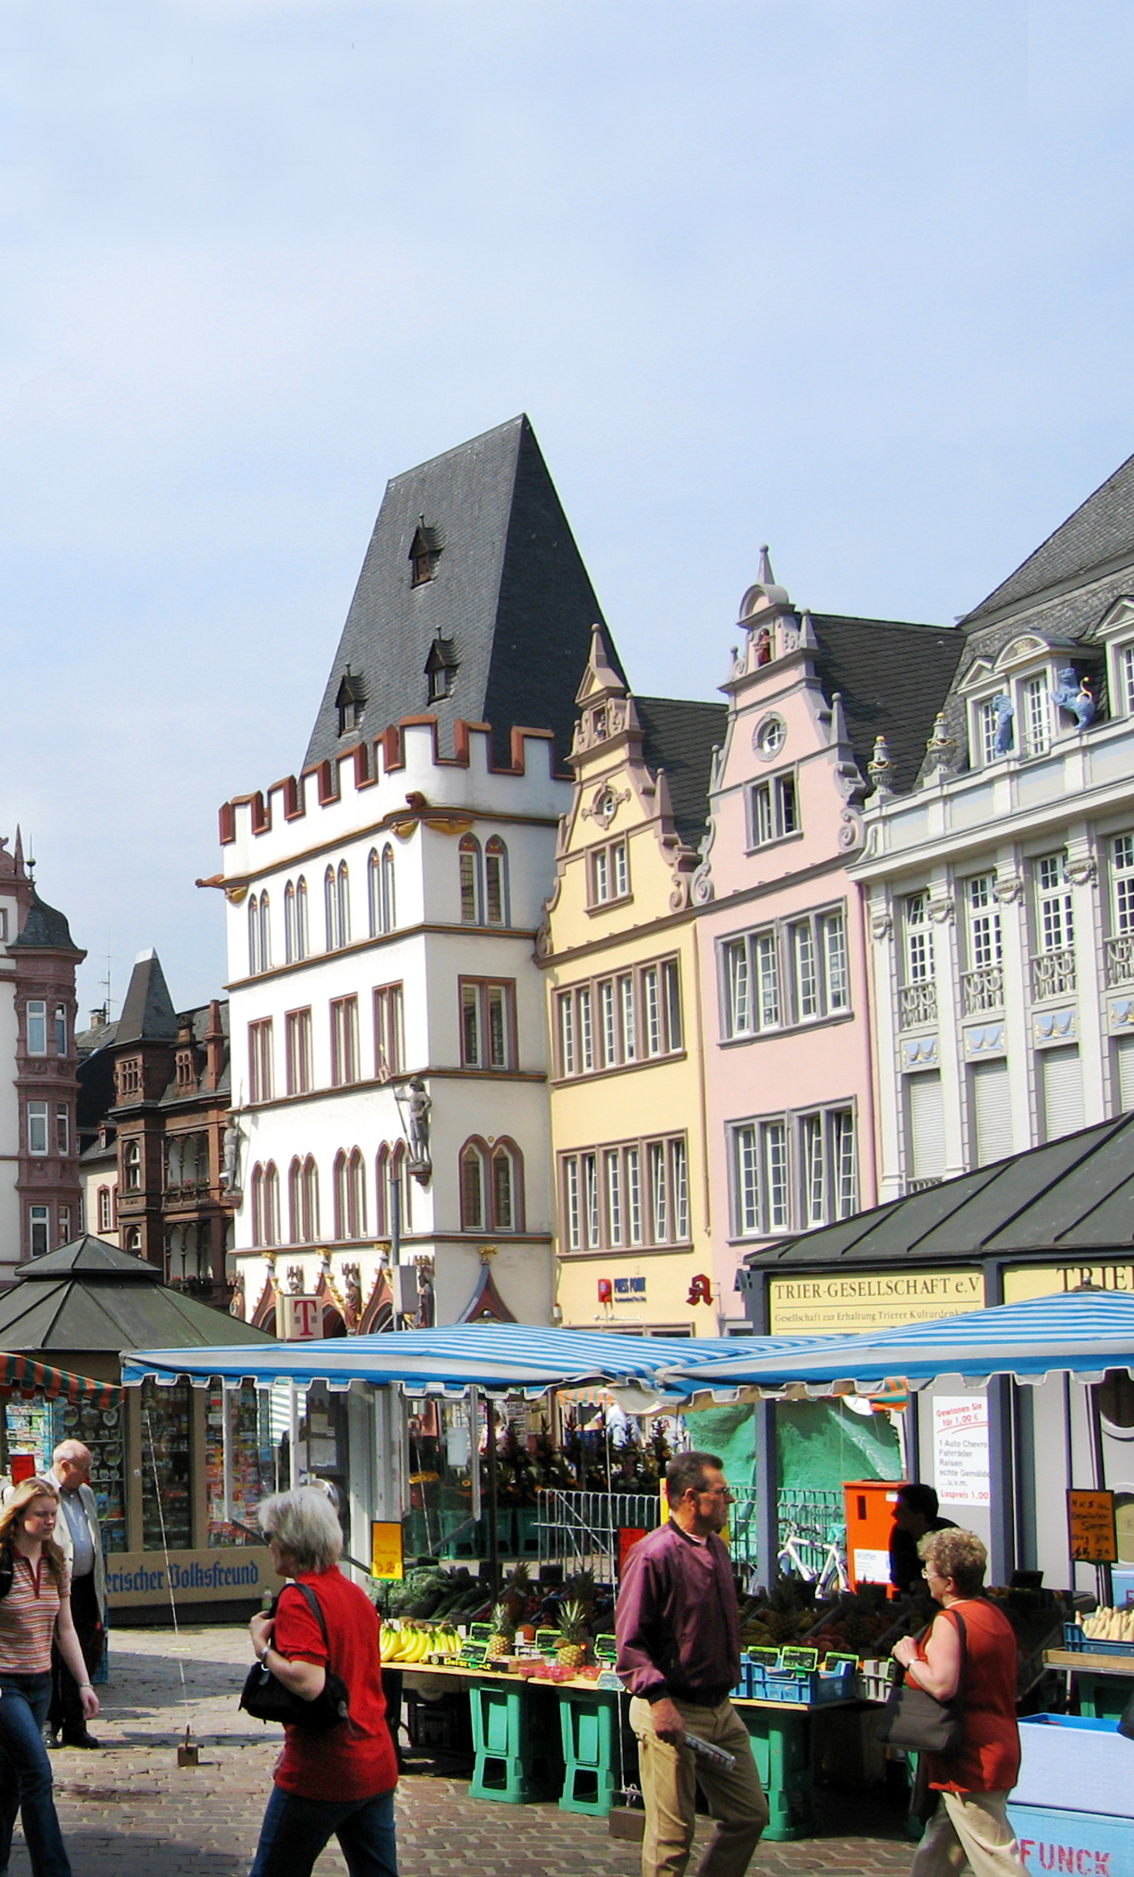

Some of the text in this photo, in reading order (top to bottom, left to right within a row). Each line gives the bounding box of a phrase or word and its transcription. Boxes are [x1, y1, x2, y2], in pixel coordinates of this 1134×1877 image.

[1056, 1265, 1134, 1293] TRIE
[775, 1277, 951, 1300] TRIER-GESELLSCHAFT
[293, 1300, 318, 1336] T
[774, 1312, 821, 1323] Gesellschaft
[822, 1314, 835, 1322] zur
[836, 1311, 876, 1323] Erhaltung
[878, 1310, 908, 1320] Trierer
[935, 1402, 983, 1418] Gewinnen Sie
[942, 1418, 953, 1427] für
[945, 1439, 961, 1448] Auto
[962, 1439, 989, 1449] Chevro
[939, 1449, 973, 1458] Fahrräder
[939, 1458, 964, 1467] Reisen
[939, 1469, 959, 1477] echte
[1020, 1838, 1110, 1877] FUNCK
